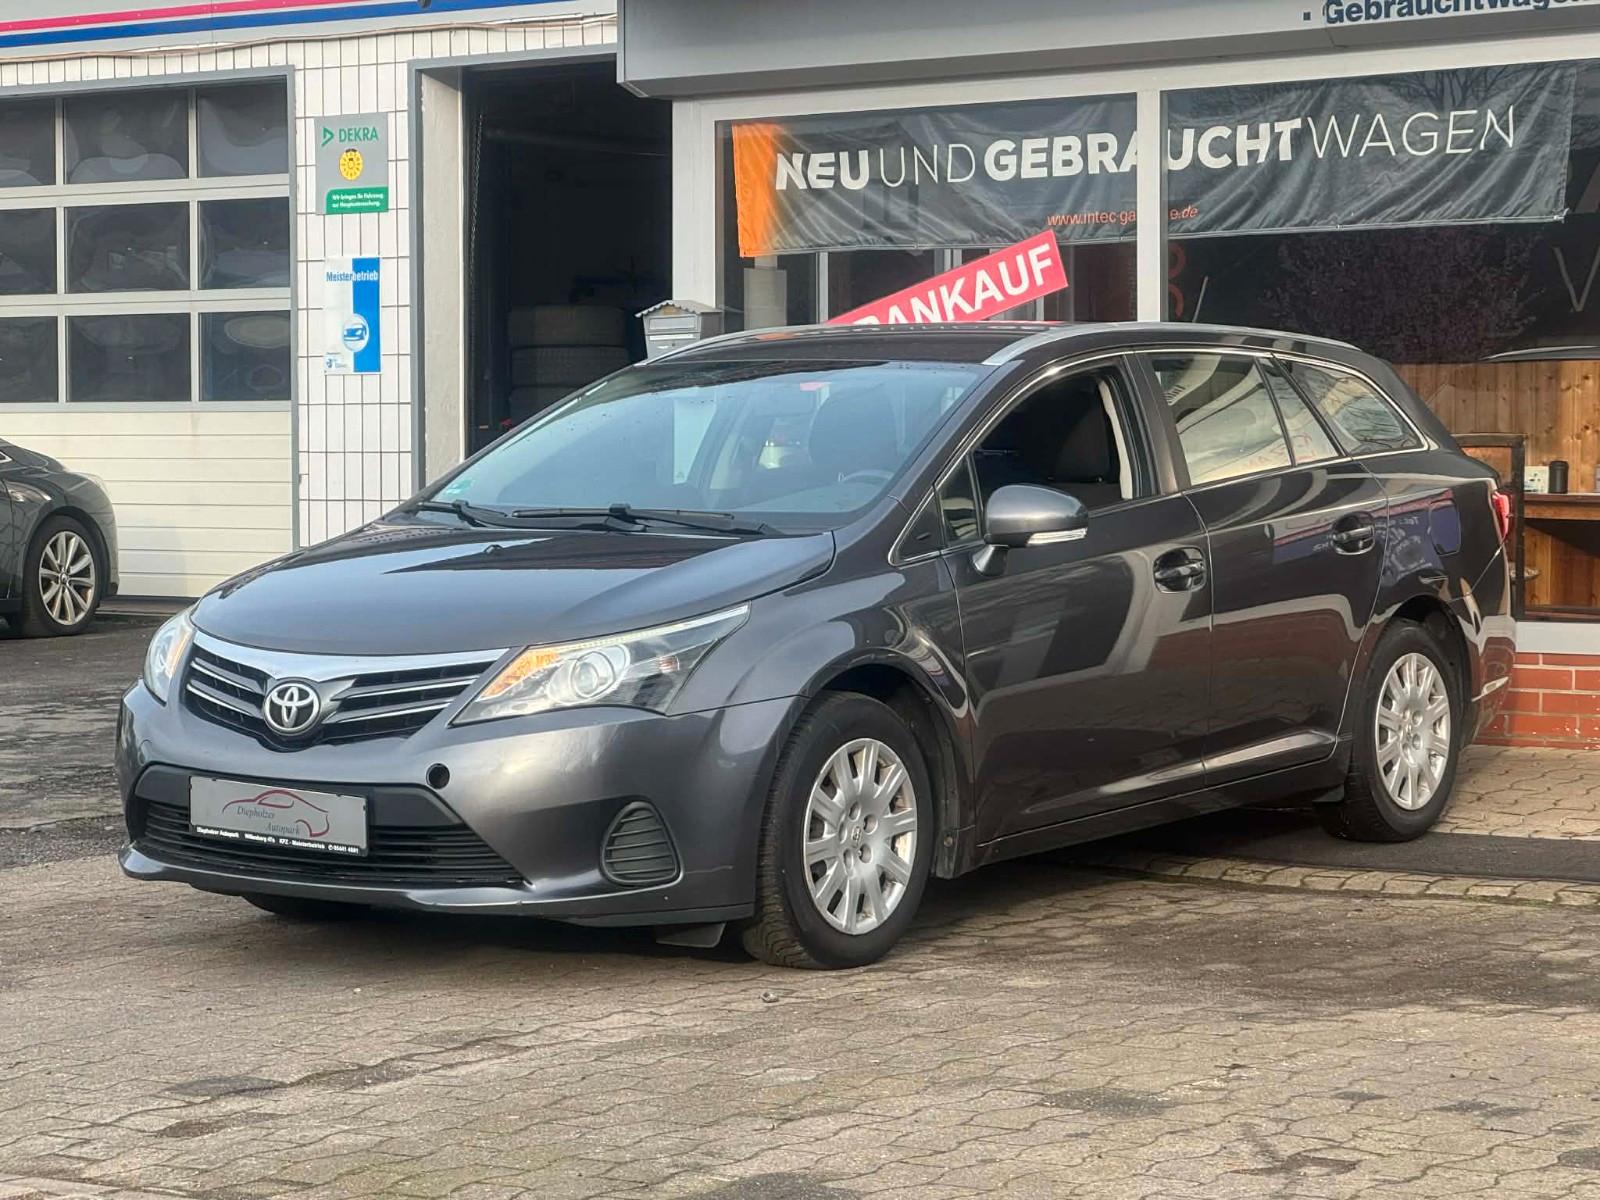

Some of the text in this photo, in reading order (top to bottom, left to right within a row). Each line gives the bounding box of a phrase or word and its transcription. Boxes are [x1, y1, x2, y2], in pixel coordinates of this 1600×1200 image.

[1327, 0, 1580, 24] Gebrauc
[339, 127, 379, 142] DEKRA
[1047, 205, 1199, 226] www.intec-gae.de
[326, 269, 379, 282] Meisterbetrieb
[853, 243, 1052, 324] ANKAUF
[237, 806, 275, 819] Diepholzer
[265, 821, 300, 835] Autopark
